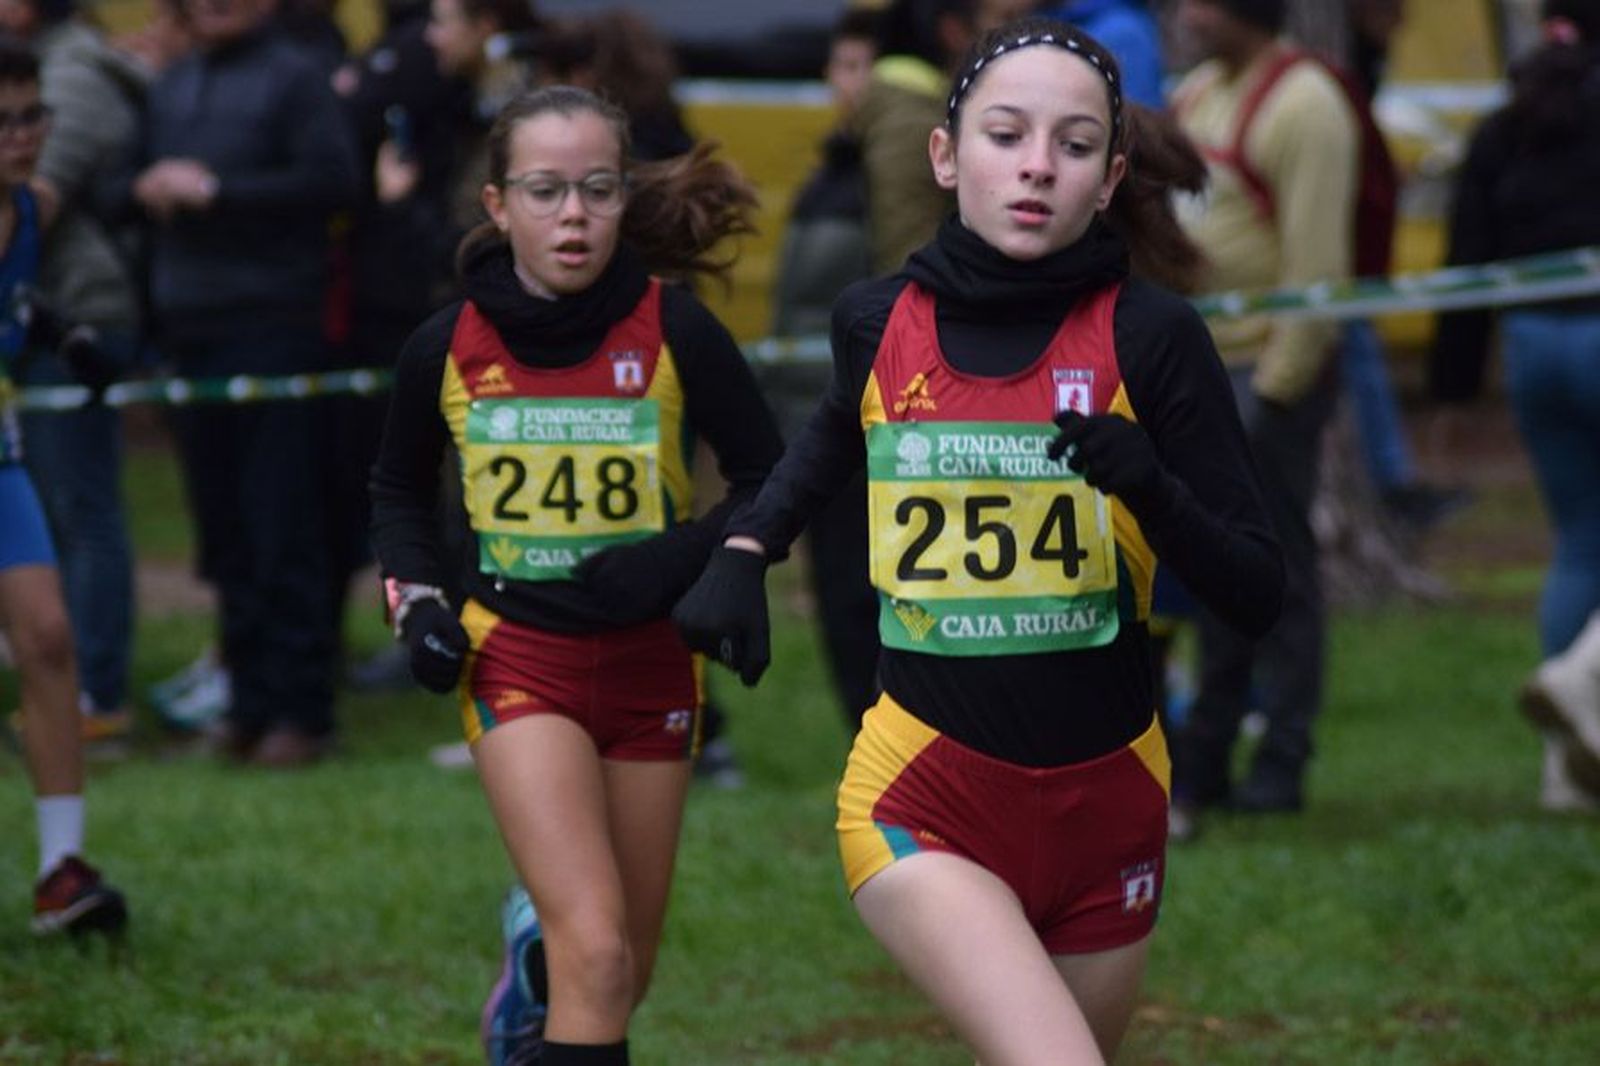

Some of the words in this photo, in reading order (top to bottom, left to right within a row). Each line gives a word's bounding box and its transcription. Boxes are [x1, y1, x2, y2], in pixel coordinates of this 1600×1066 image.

[522, 424, 566, 441] CAJA
[570, 424, 632, 441] RURAL
[938, 434, 1074, 456] FUNDACI
[938, 455, 993, 476] CAJA
[489, 455, 639, 523] 248
[895, 493, 1088, 582] 254
[525, 548, 577, 567] CAJA
[940, 614, 1007, 639] CAJA
[1013, 608, 1104, 636] RURAL
